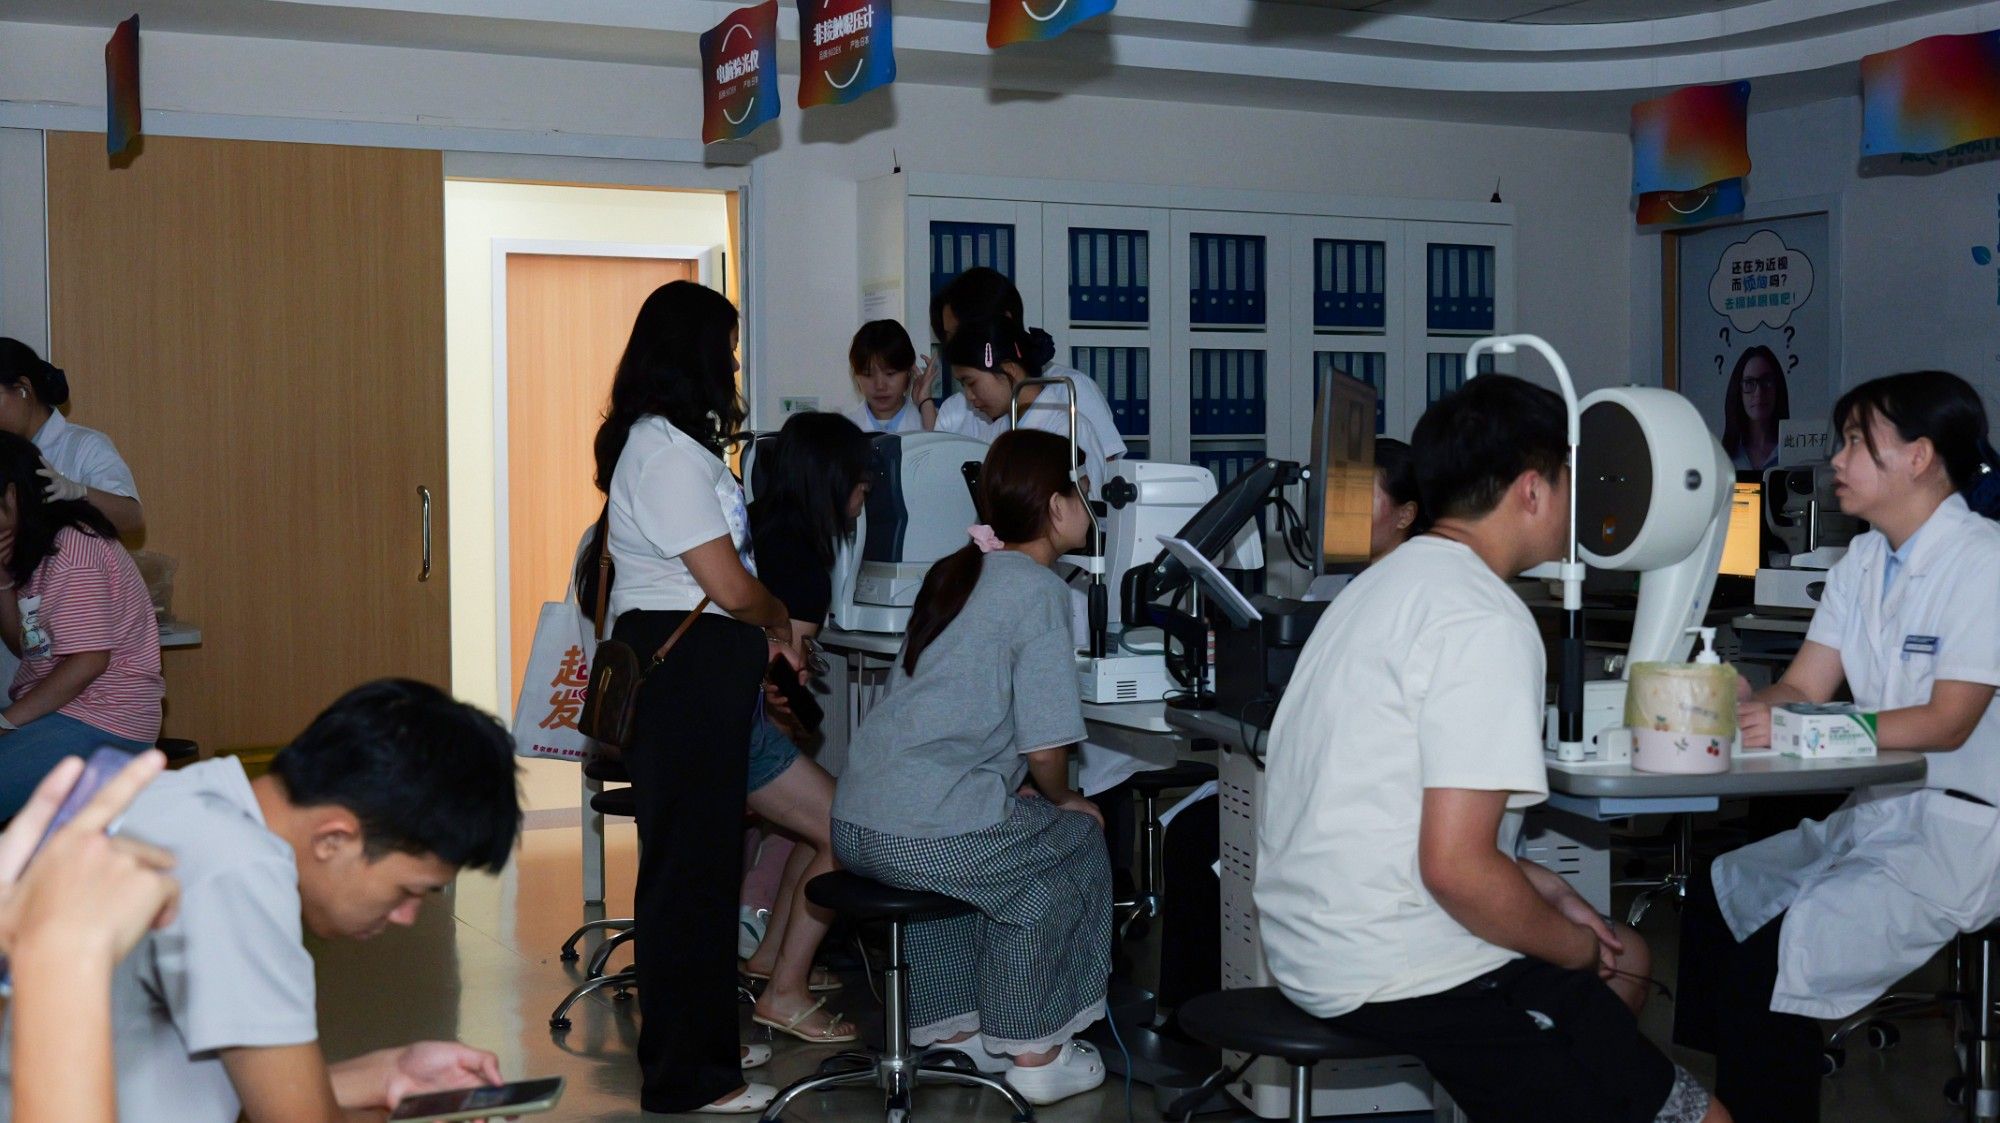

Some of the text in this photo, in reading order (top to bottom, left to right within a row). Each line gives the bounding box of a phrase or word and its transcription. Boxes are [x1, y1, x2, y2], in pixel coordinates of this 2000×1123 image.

[813, 4, 874, 46] 非接触眼压计
[716, 49, 759, 84] 电脑验光仪
[1732, 256, 1788, 274] 还在为近视
